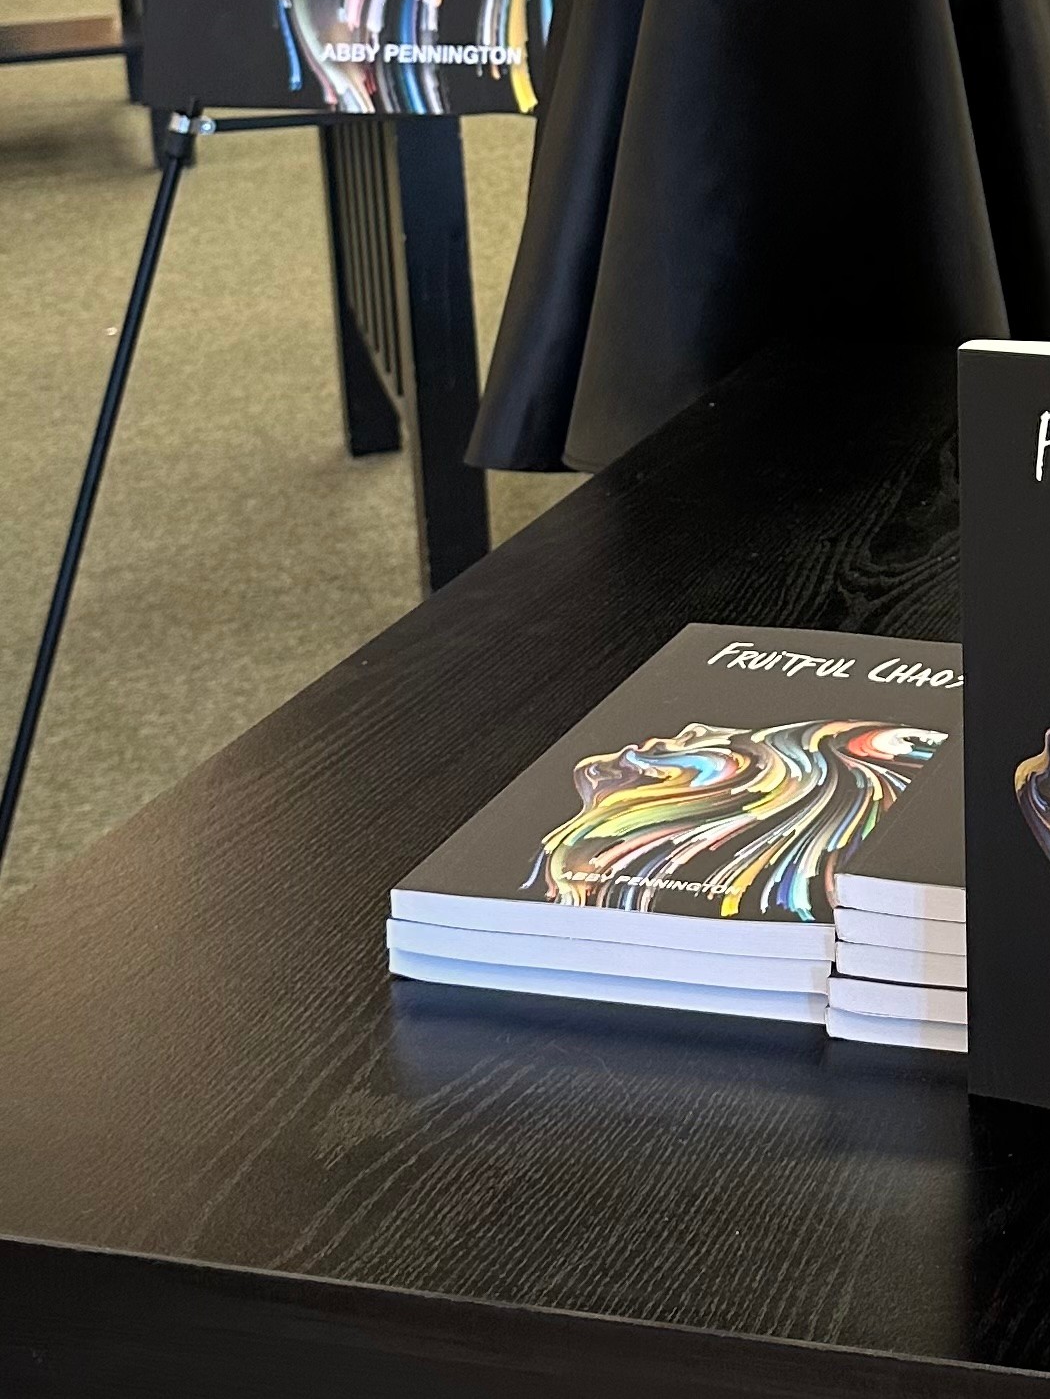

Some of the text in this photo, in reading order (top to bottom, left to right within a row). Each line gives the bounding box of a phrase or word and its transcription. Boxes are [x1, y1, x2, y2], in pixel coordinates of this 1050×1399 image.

[321, 42, 522, 65] ABBY PENNINGTON
[560, 870, 746, 895] ABBY PENNINGTON
